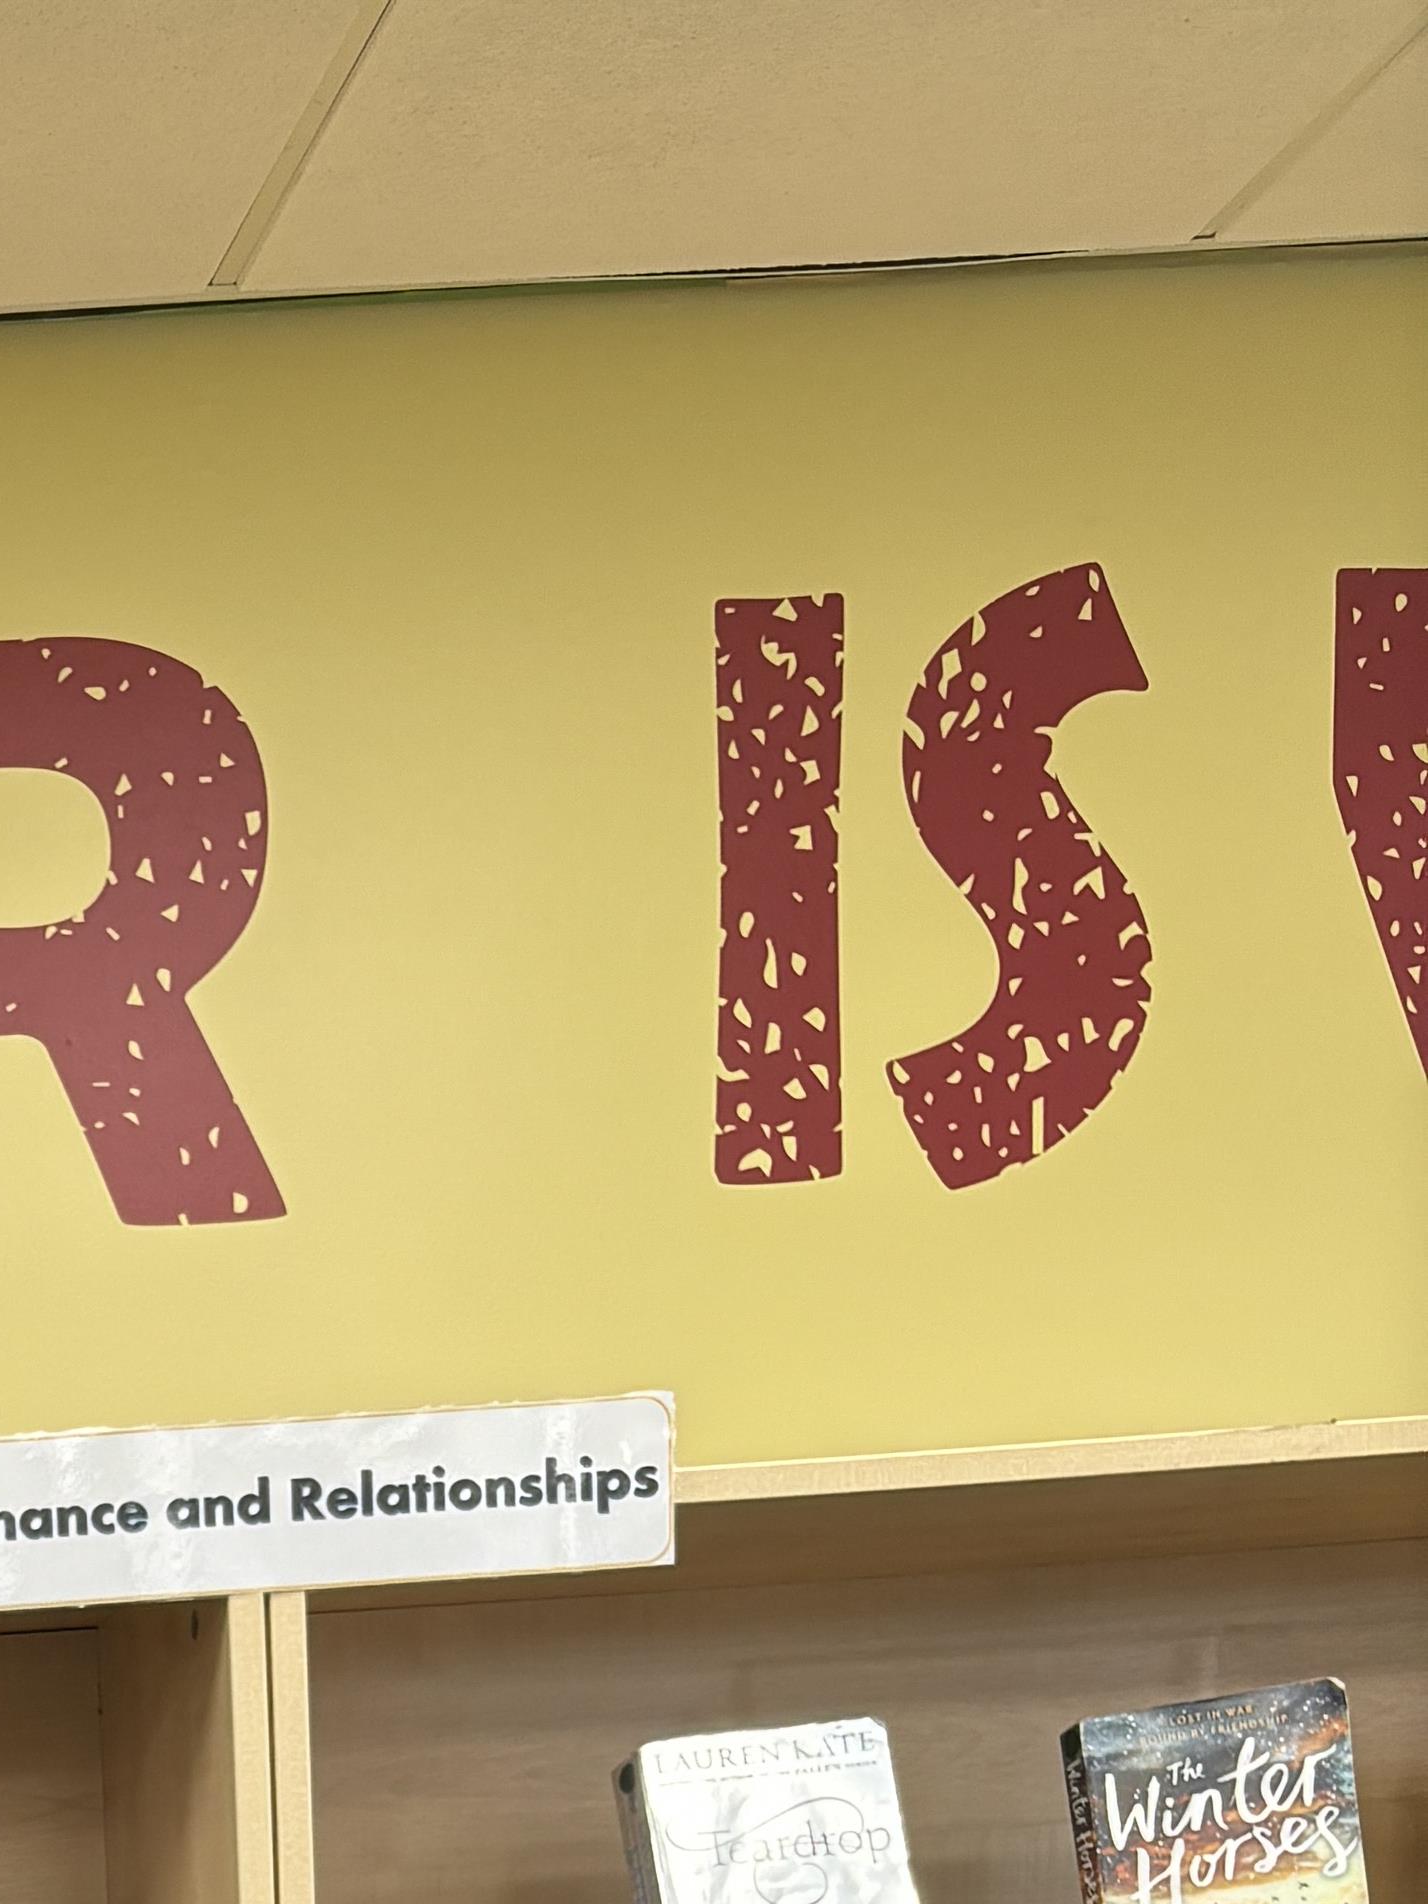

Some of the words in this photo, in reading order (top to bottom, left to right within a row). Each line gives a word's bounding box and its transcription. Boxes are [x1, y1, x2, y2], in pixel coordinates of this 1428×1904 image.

[715, 563, 1152, 1191] IS
[166, 1477, 272, 1529] and
[291, 1456, 660, 1521] Relationships
[1207, 1710, 1220, 1720] IN
[1226, 1705, 1254, 1718] WAR
[1210, 1714, 1288, 1736] FRIENDSHIP
[655, 1745, 779, 1773] LAUREN
[794, 1732, 876, 1758] KATE
[1166, 1756, 1205, 1786] The
[1105, 1736, 1336, 1850] Winter
[697, 1819, 890, 1868] Teardrop
